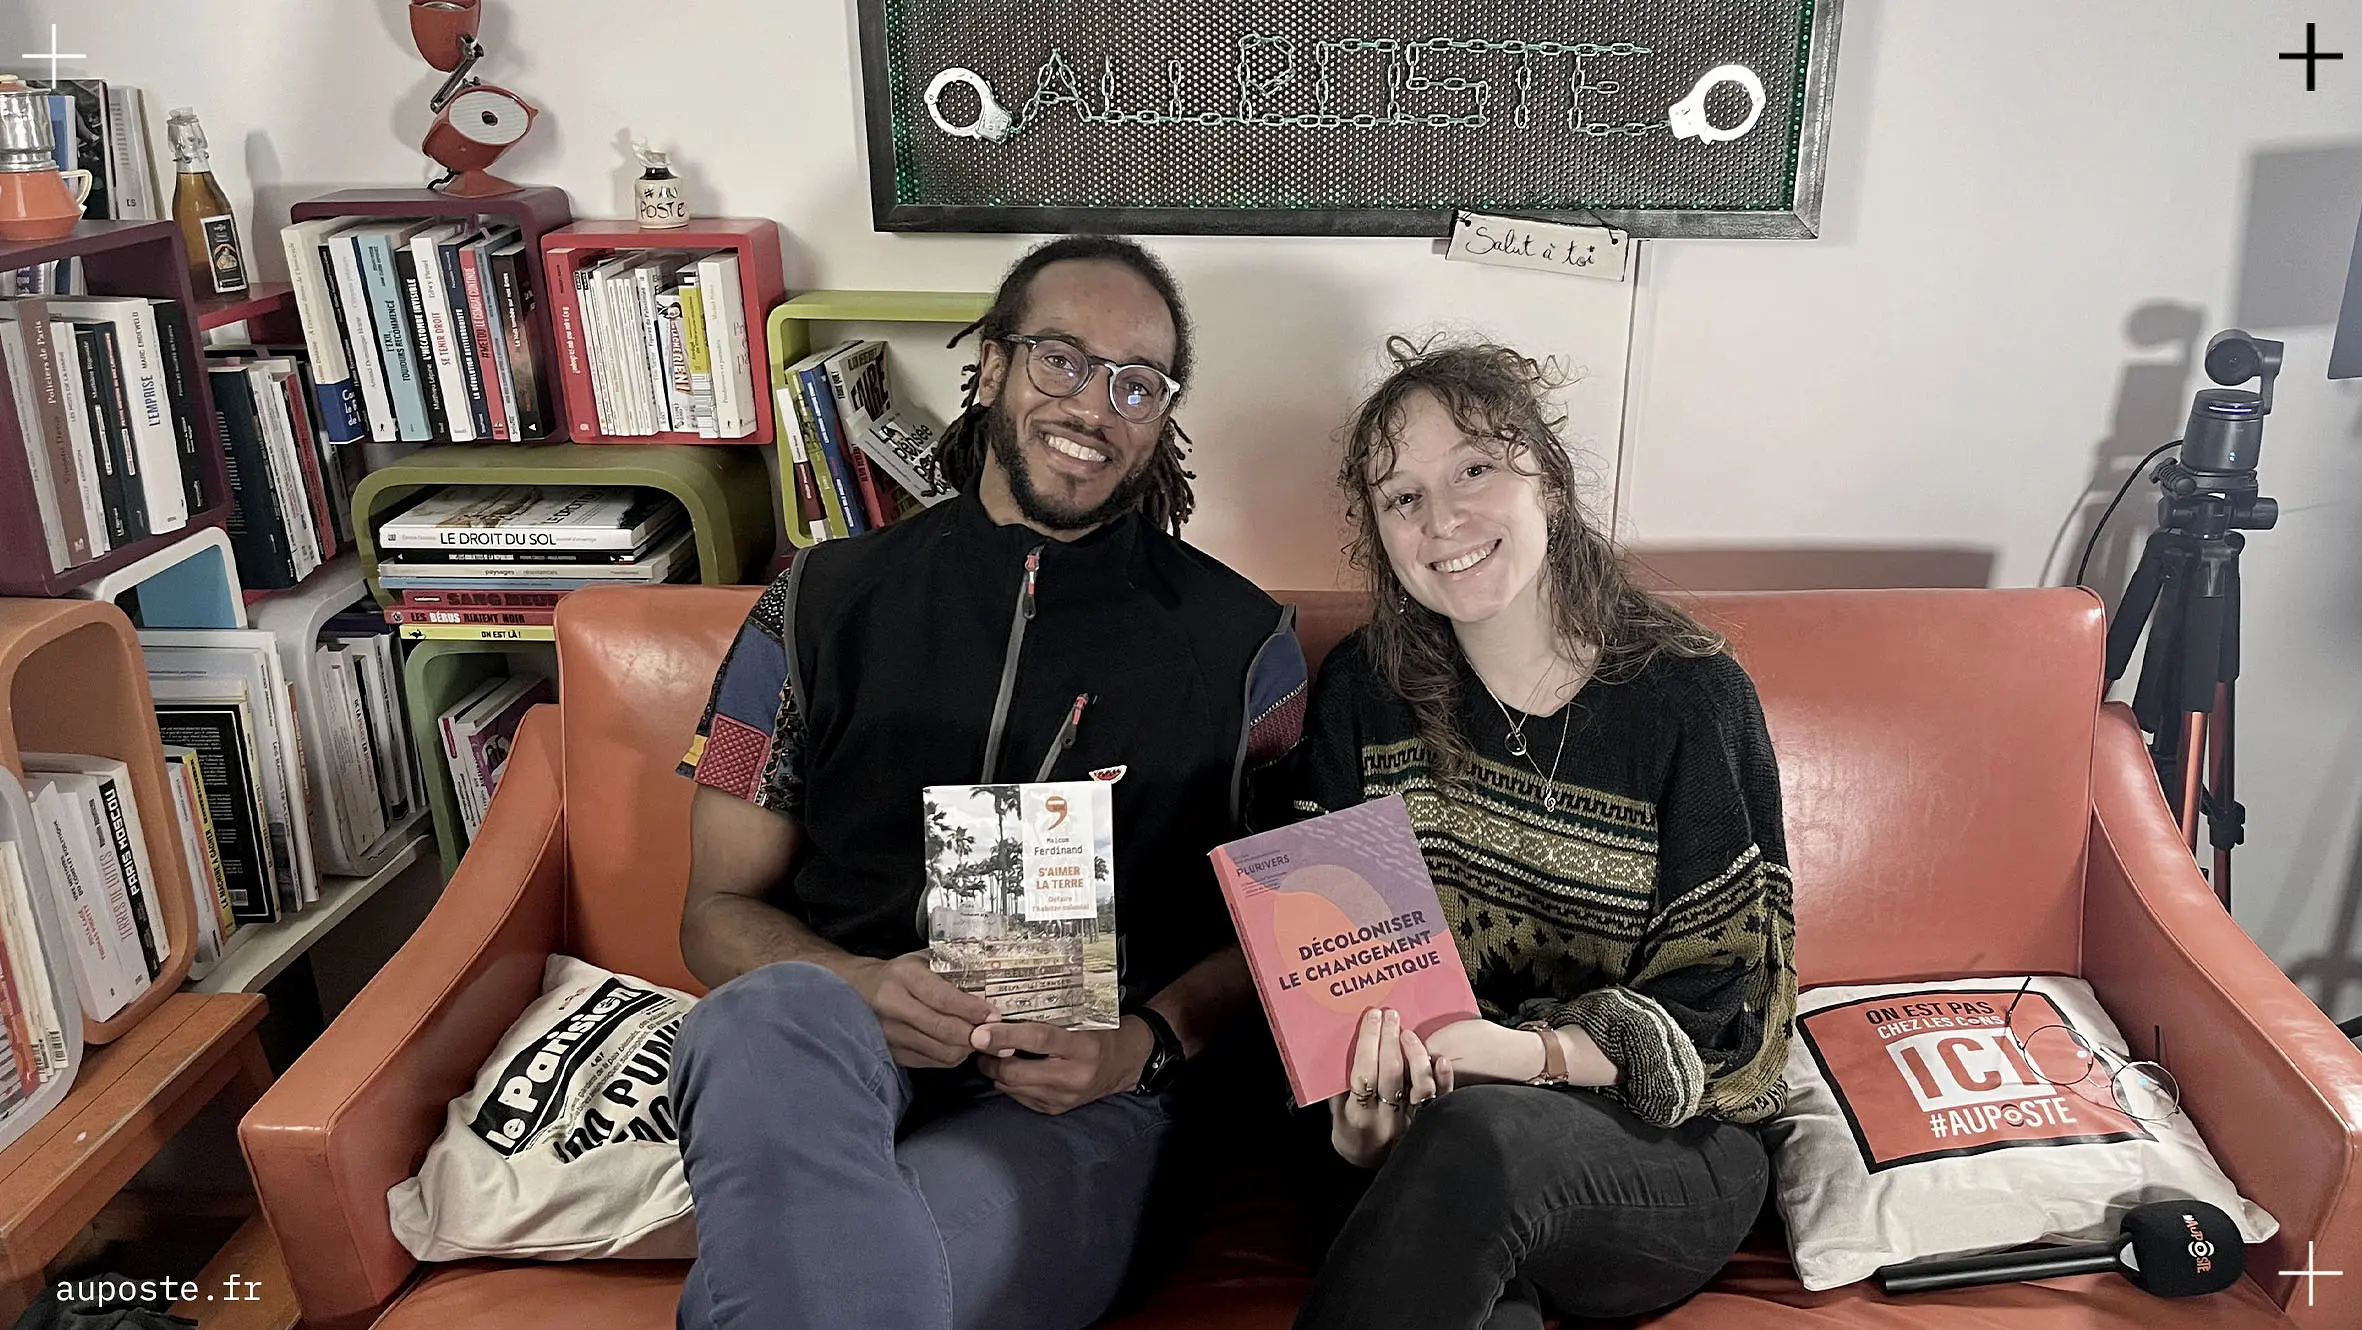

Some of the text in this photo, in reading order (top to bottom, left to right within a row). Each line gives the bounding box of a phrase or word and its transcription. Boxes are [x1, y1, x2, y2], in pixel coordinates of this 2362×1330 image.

[640, 200, 685, 219] POSTE
[1465, 227, 1535, 256] Salut
[1562, 240, 1596, 267] toi
[33, 319, 45, 346] Paris
[406, 277, 432, 361] L'HÉCATOMBE INVISIBLE
[39, 347, 47, 361] de
[384, 299, 411, 382] TOUJOURS RECOMMENCÉ
[431, 311, 452, 367] SE TENIR DROIT
[41, 361, 56, 406] Policiers
[141, 373, 161, 428] L'EMPRISE
[892, 423, 934, 464] pensée
[440, 533, 557, 545] LE DROIT DU SOL
[411, 611, 526, 624] LES BÉRUS RIAIENT NOIR
[481, 631, 491, 639] ON
[493, 631, 506, 639] EST
[103, 788, 142, 896] PARIS MOSCOU
[204, 828, 219, 859] GAGNER
[1034, 845, 1083, 856] Ferdinand
[213, 865, 228, 898] MACHINE
[1038, 866, 1080, 877] S'AIMER
[1236, 854, 1290, 877] PLURIVERS
[97, 850, 135, 941] TERRES DE LUTTES
[1036, 878, 1084, 890] LA TERRE
[221, 897, 229, 909] LA
[1299, 910, 1427, 962] DÉCOLONISER
[1279, 930, 1433, 990] LE CHANGEMENT
[1329, 951, 1441, 998] CLIMATIQUE
[1866, 1000, 1995, 1025] ON EST PAS
[1877, 1018, 1923, 1040] CHEZ
[1922, 1015, 1955, 1031] LES
[497, 986, 643, 1114] Parisien
[1898, 1034, 2044, 1100] ICI
[486, 1118, 527, 1149] le
[1930, 1096, 2078, 1139] #AUPOSTE
